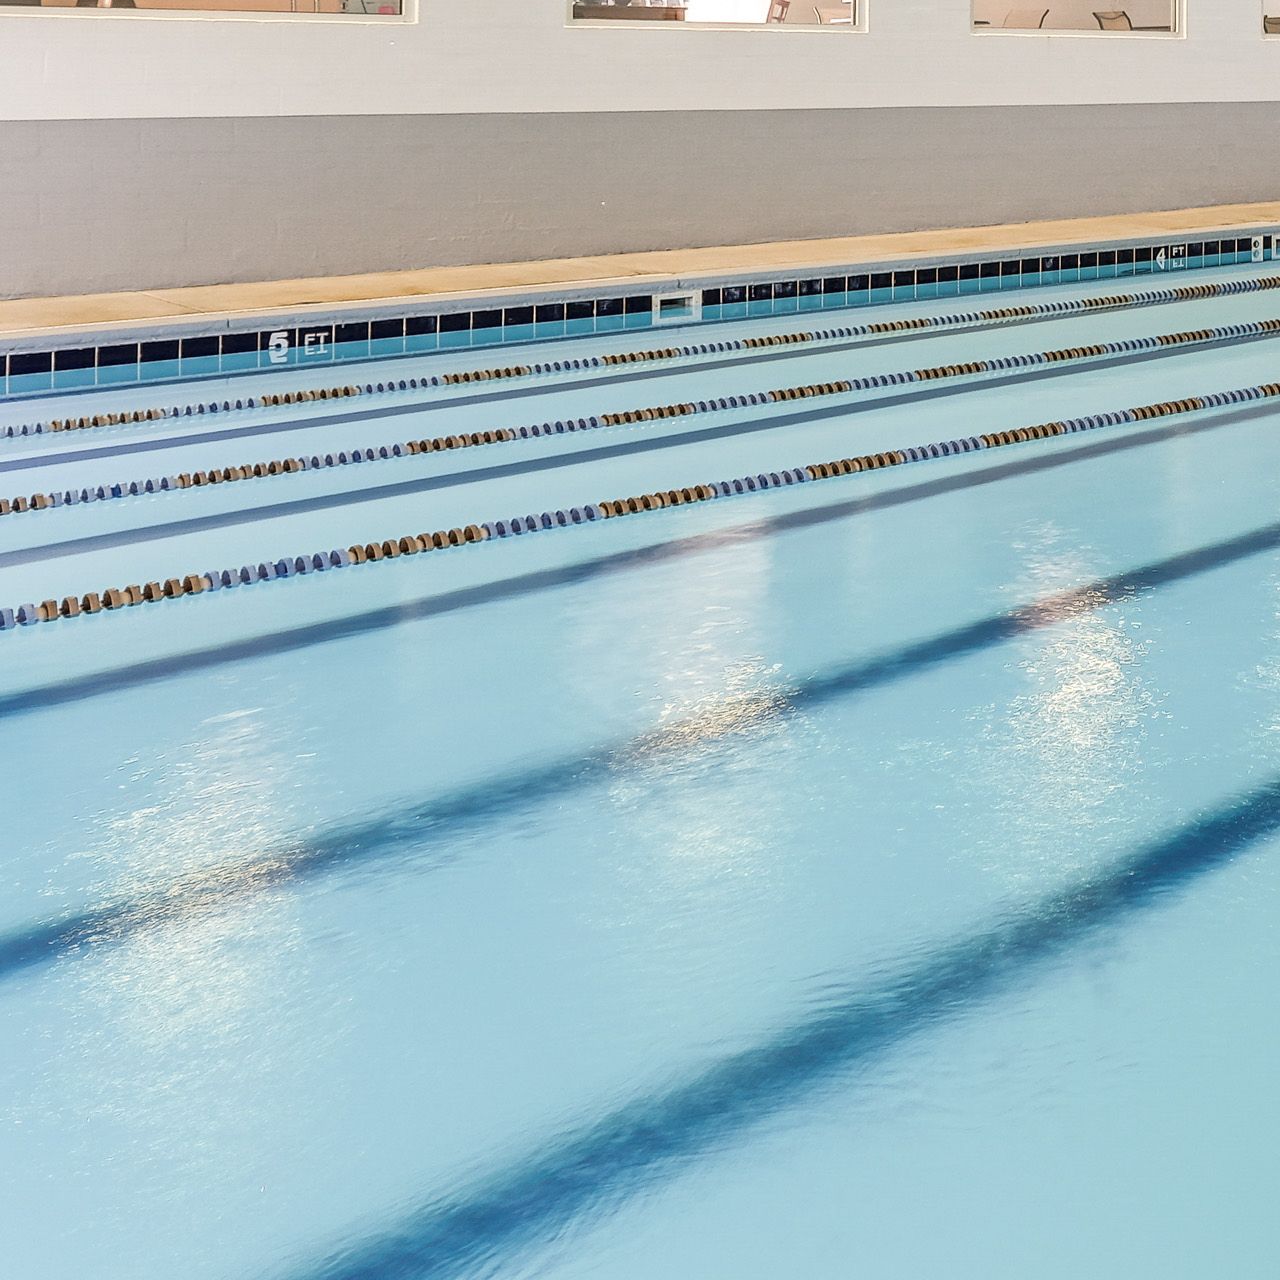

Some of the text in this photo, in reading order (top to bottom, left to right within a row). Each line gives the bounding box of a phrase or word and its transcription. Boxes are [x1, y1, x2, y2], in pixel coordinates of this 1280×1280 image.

[1172, 246, 1185, 257] FT
[268, 331, 329, 350] 5 FT
